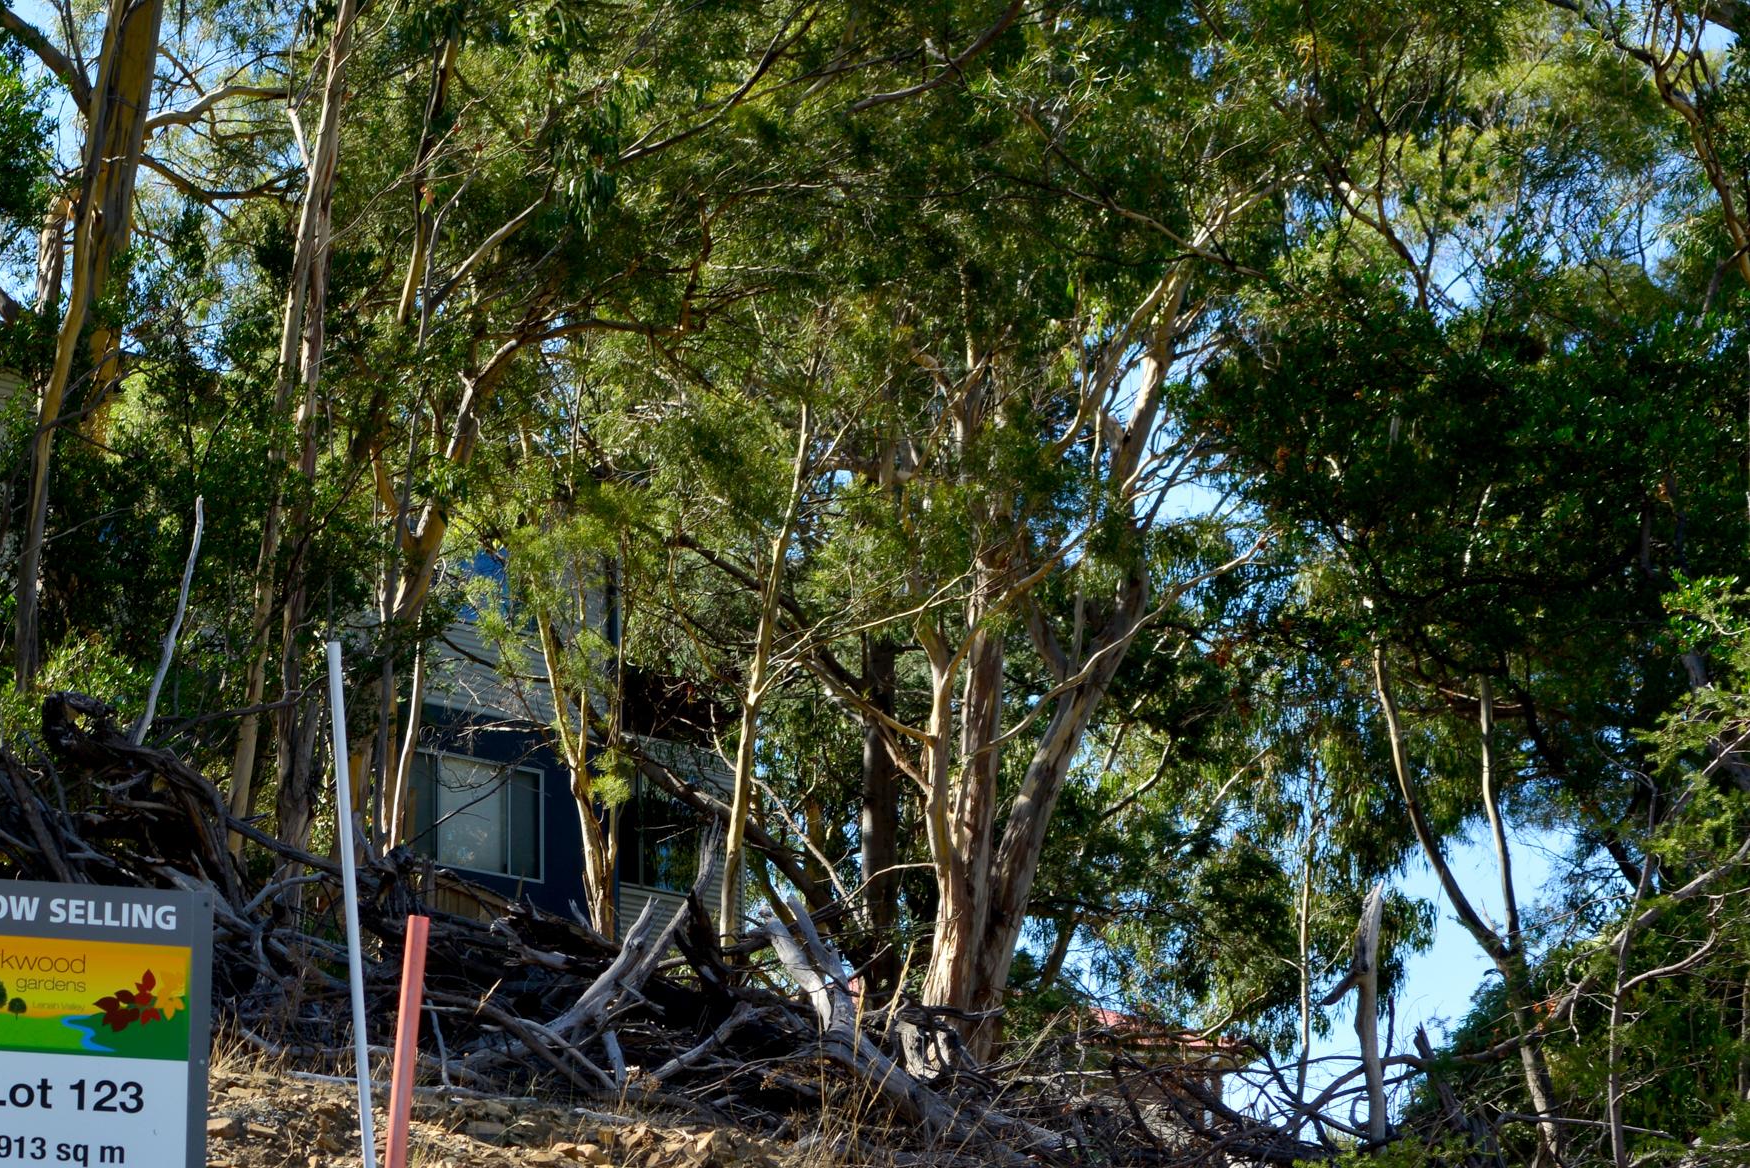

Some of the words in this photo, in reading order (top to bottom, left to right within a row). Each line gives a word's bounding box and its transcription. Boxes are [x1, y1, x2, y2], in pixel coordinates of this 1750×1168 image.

[49, 897, 177, 931] SELLING
[16, 974, 86, 993] gardens
[70, 1079, 144, 1114] 123
[56, 1142, 89, 1167] sq
[99, 1144, 125, 1164] m
